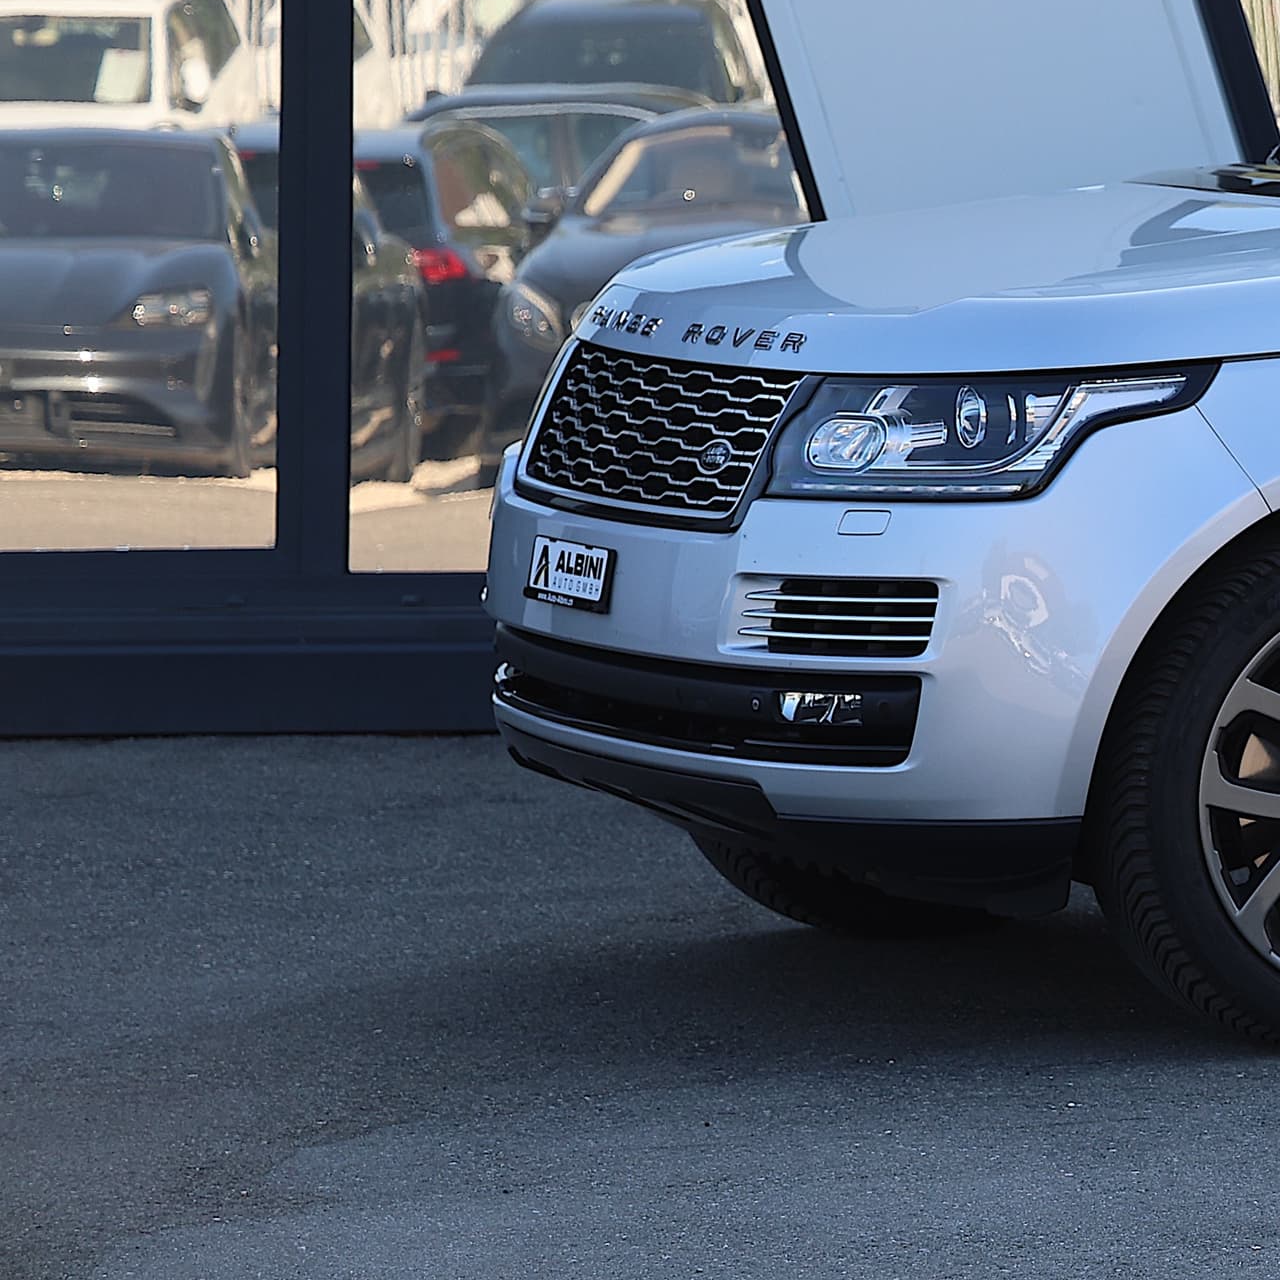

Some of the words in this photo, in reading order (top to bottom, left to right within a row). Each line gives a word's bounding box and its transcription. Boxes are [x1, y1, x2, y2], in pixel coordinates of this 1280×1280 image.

[592, 305, 664, 337] RANGE
[682, 323, 808, 354] ROVER
[555, 550, 604, 581] ALBINI
[553, 576, 574, 591] AUTO
